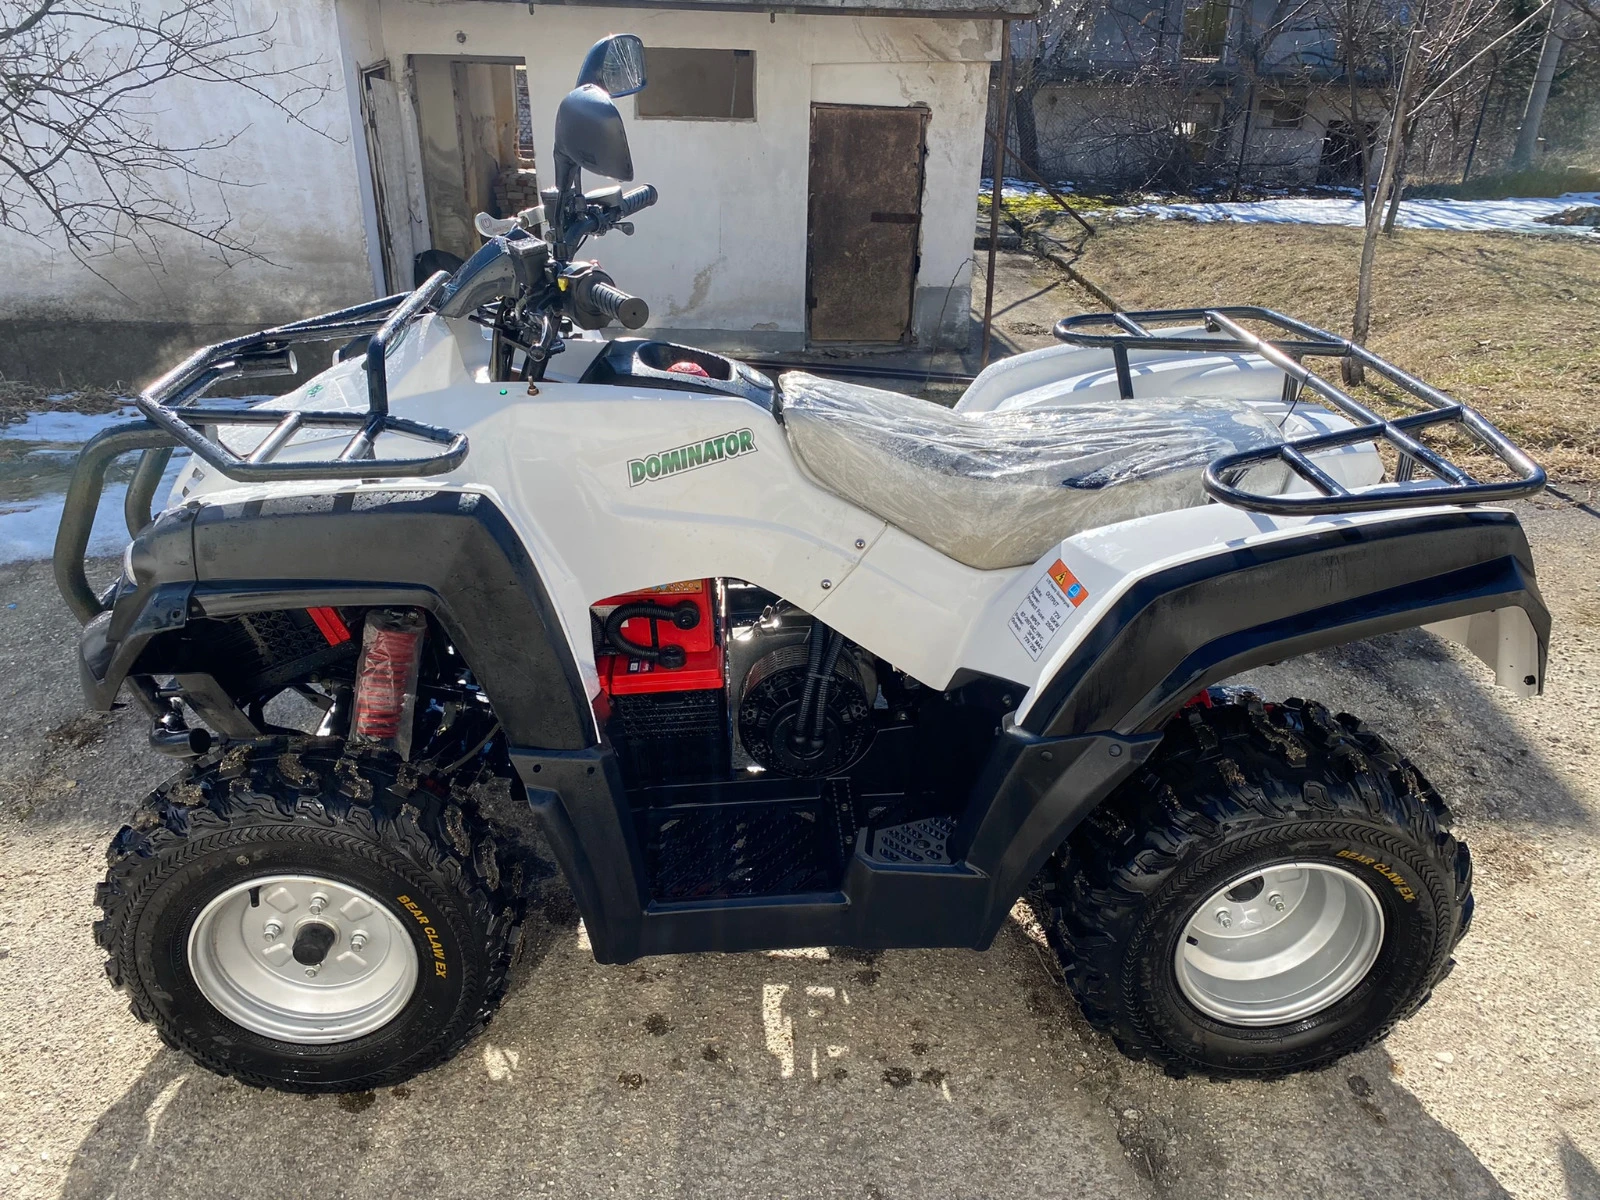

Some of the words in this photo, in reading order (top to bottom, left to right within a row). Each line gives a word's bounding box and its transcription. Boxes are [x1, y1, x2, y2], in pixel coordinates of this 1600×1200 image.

[629, 429, 756, 485] DOMINATOR
[1045, 591, 1060, 607] OUTPUT
[1336, 850, 1375, 865] BEAR
[1373, 863, 1406, 887] CLAW
[1399, 886, 1416, 903] EX
[396, 895, 430, 924] BEAR
[424, 927, 446, 960] CLAW
[435, 961, 447, 979] EX
